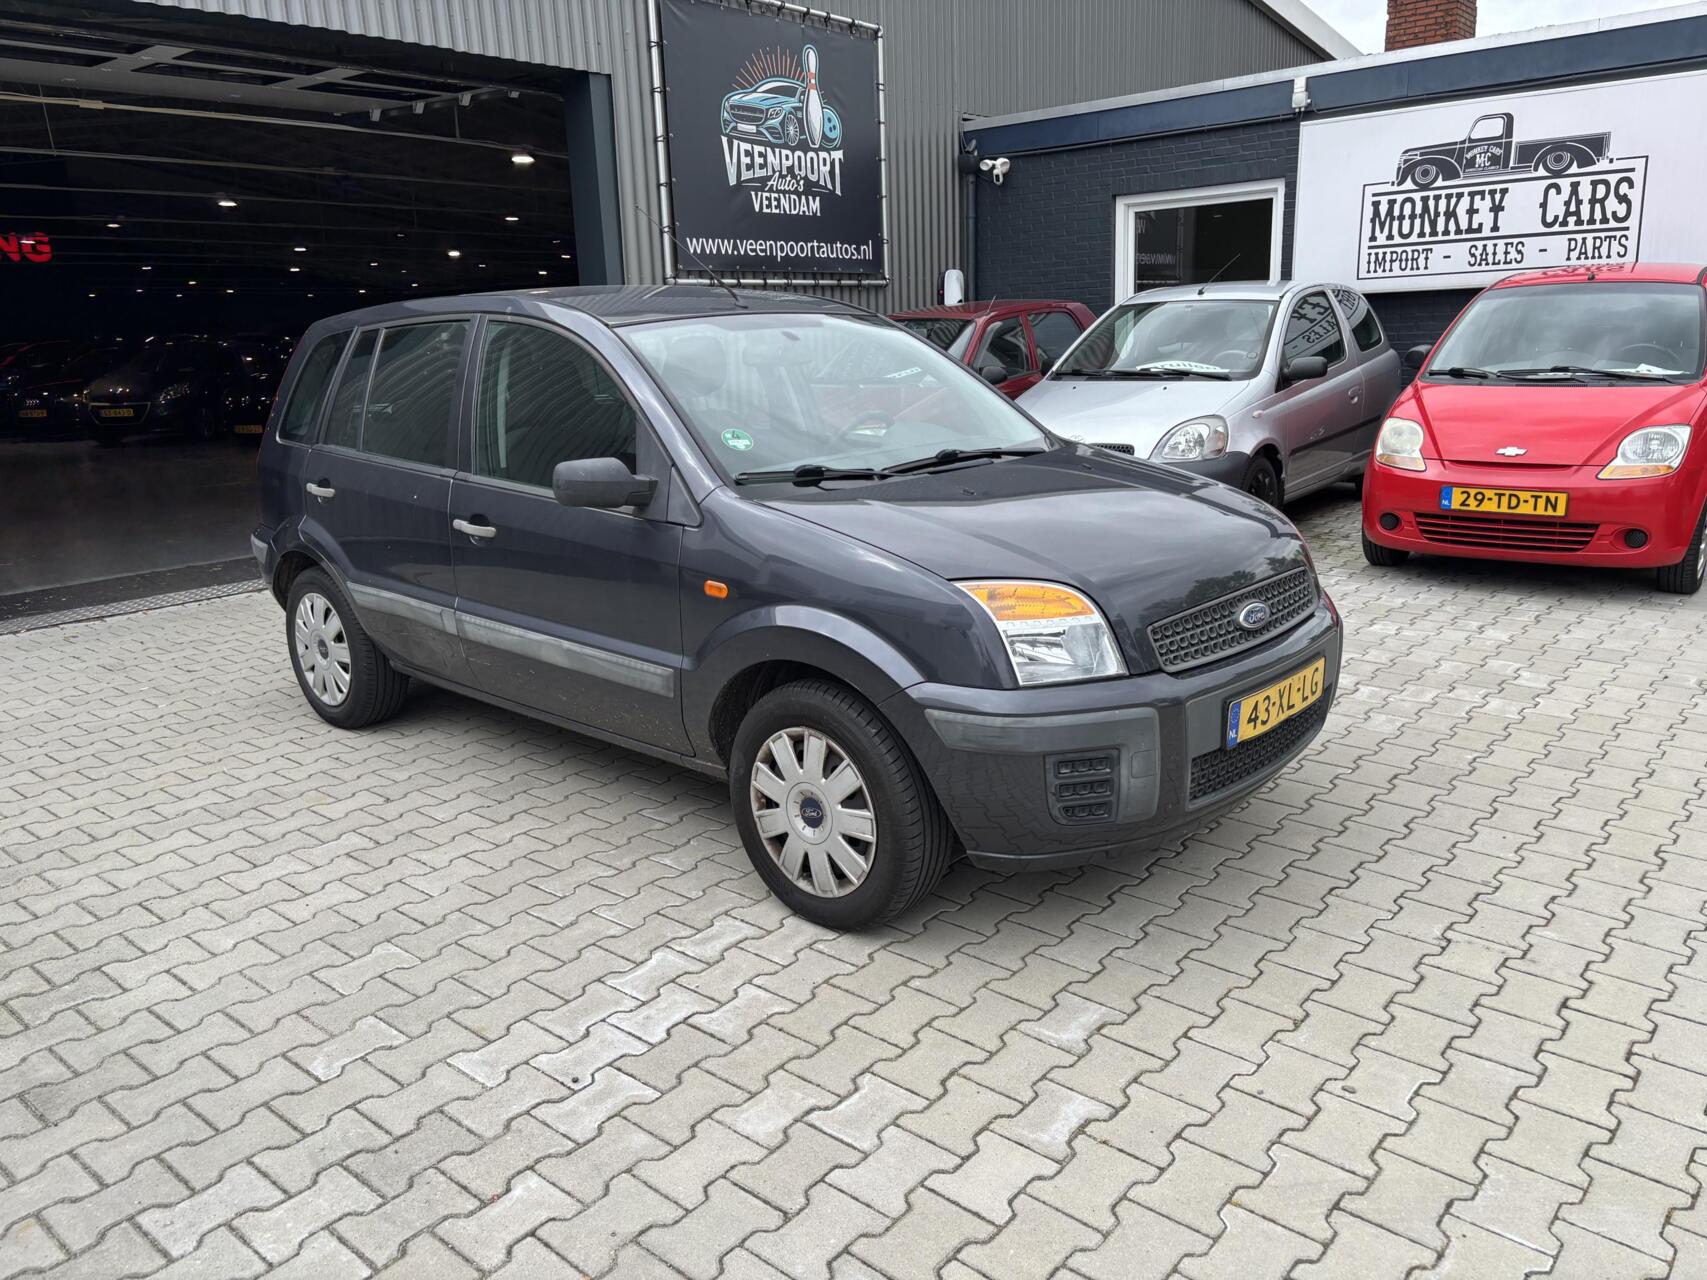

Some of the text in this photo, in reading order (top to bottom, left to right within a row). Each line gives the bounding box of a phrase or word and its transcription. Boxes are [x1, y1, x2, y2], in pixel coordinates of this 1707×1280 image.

[721, 136, 844, 196] VEENPOORT
[765, 172, 804, 191] Auto's
[750, 191, 821, 216] VEENDAM
[1368, 176, 1634, 243] MONKEY CARS
[686, 236, 873, 262] www.veenpoortautos.nl
[1366, 247, 1433, 275] IMPORT
[1467, 241, 1525, 267] SALES
[1565, 234, 1628, 262] PARTS
[1459, 490, 1559, 513] 29-TD-TN
[1228, 667, 1319, 739] NL 43-XL-LG
